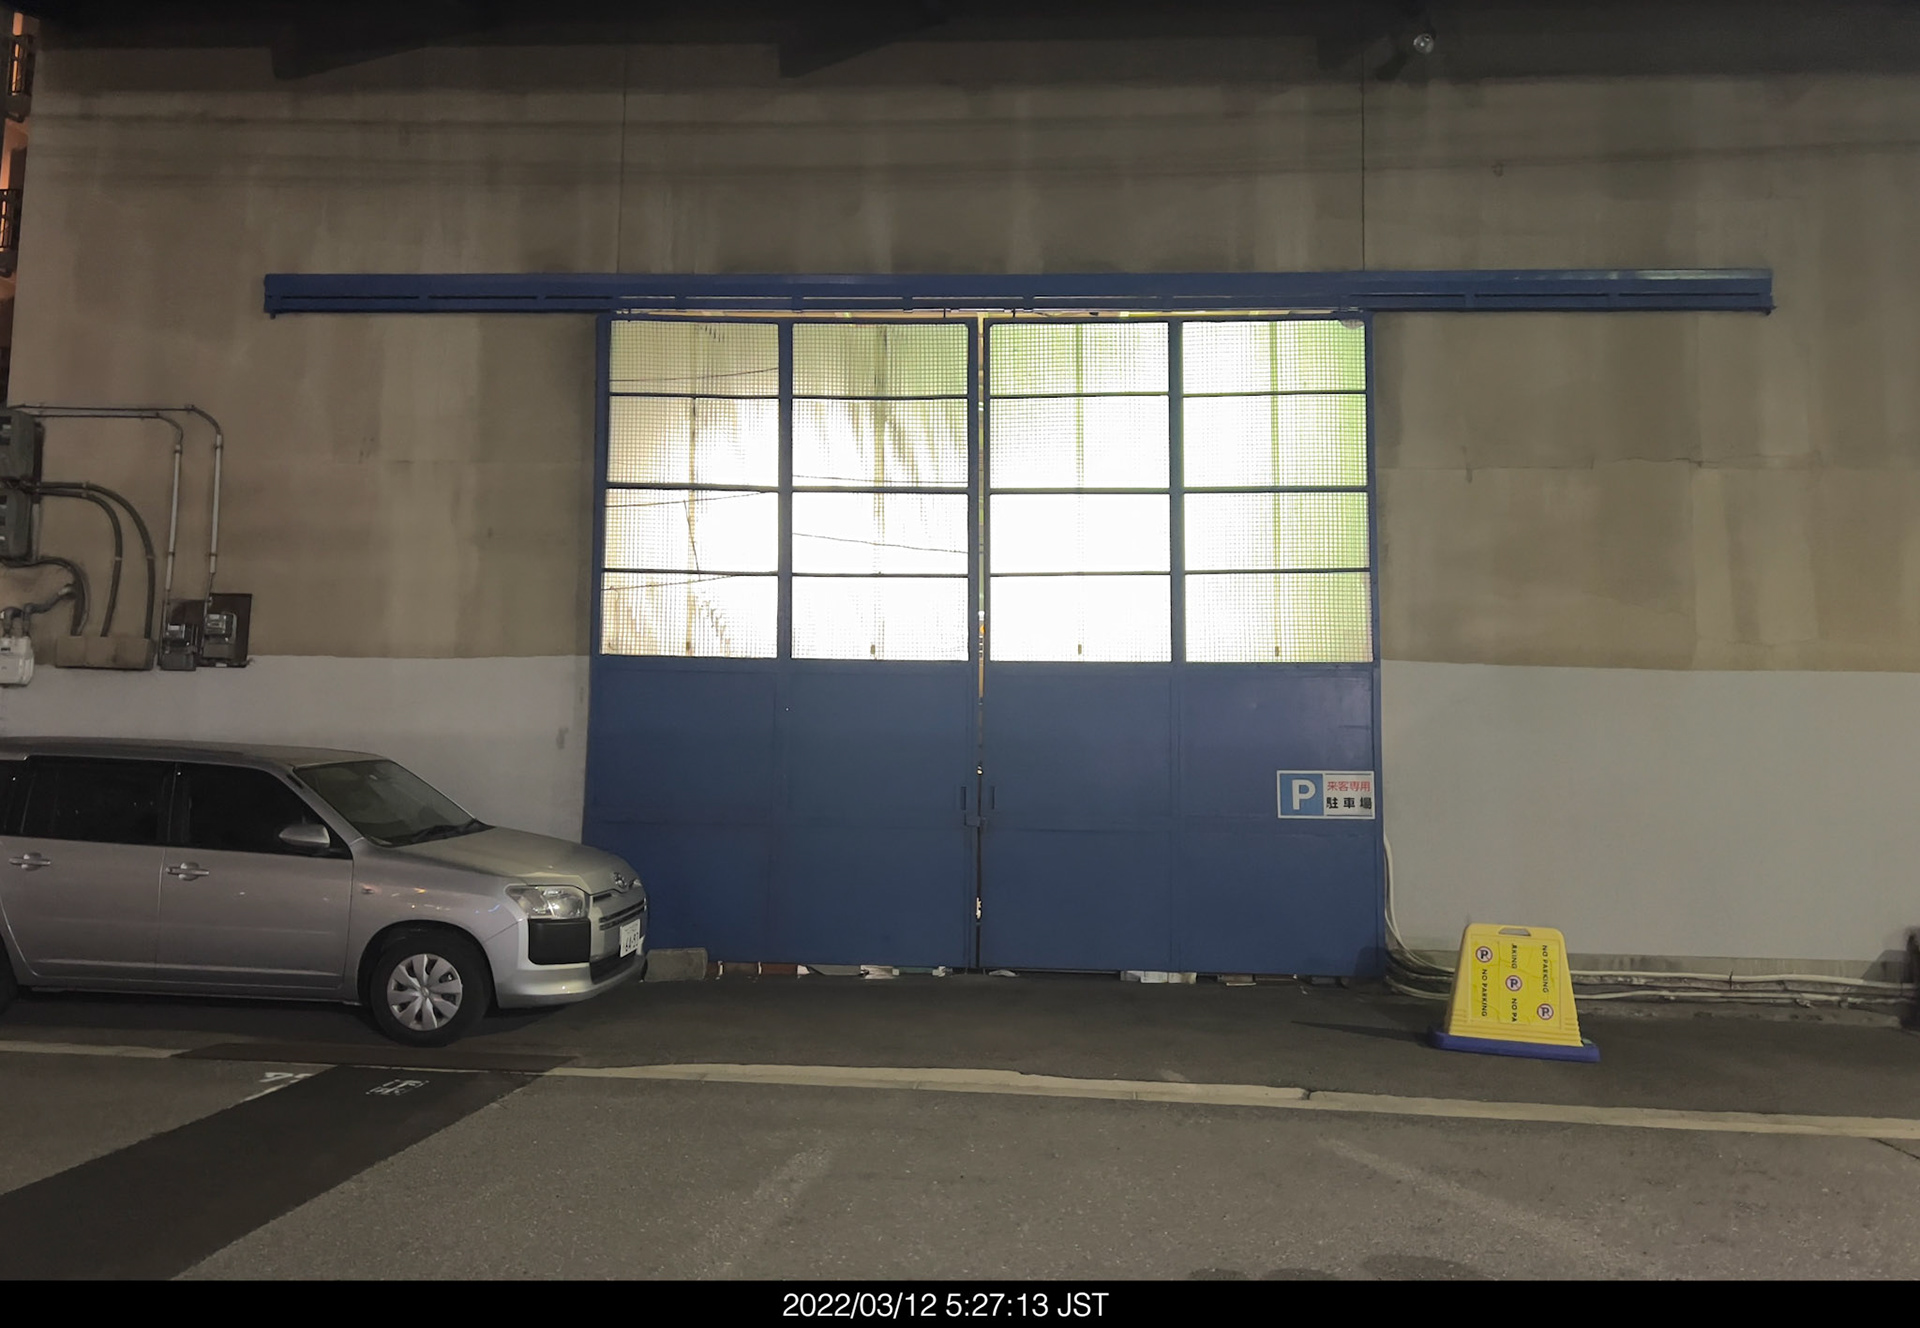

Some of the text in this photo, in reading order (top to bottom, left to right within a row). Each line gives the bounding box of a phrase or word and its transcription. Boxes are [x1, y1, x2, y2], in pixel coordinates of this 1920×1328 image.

[1327, 781, 1371, 792] 来客専用
[1292, 779, 1316, 810] P
[1326, 797, 1372, 809] 駐車場
[1542, 945, 1548, 957] NO
[1481, 969, 1488, 981] NO
[1511, 998, 1518, 1010] NO
